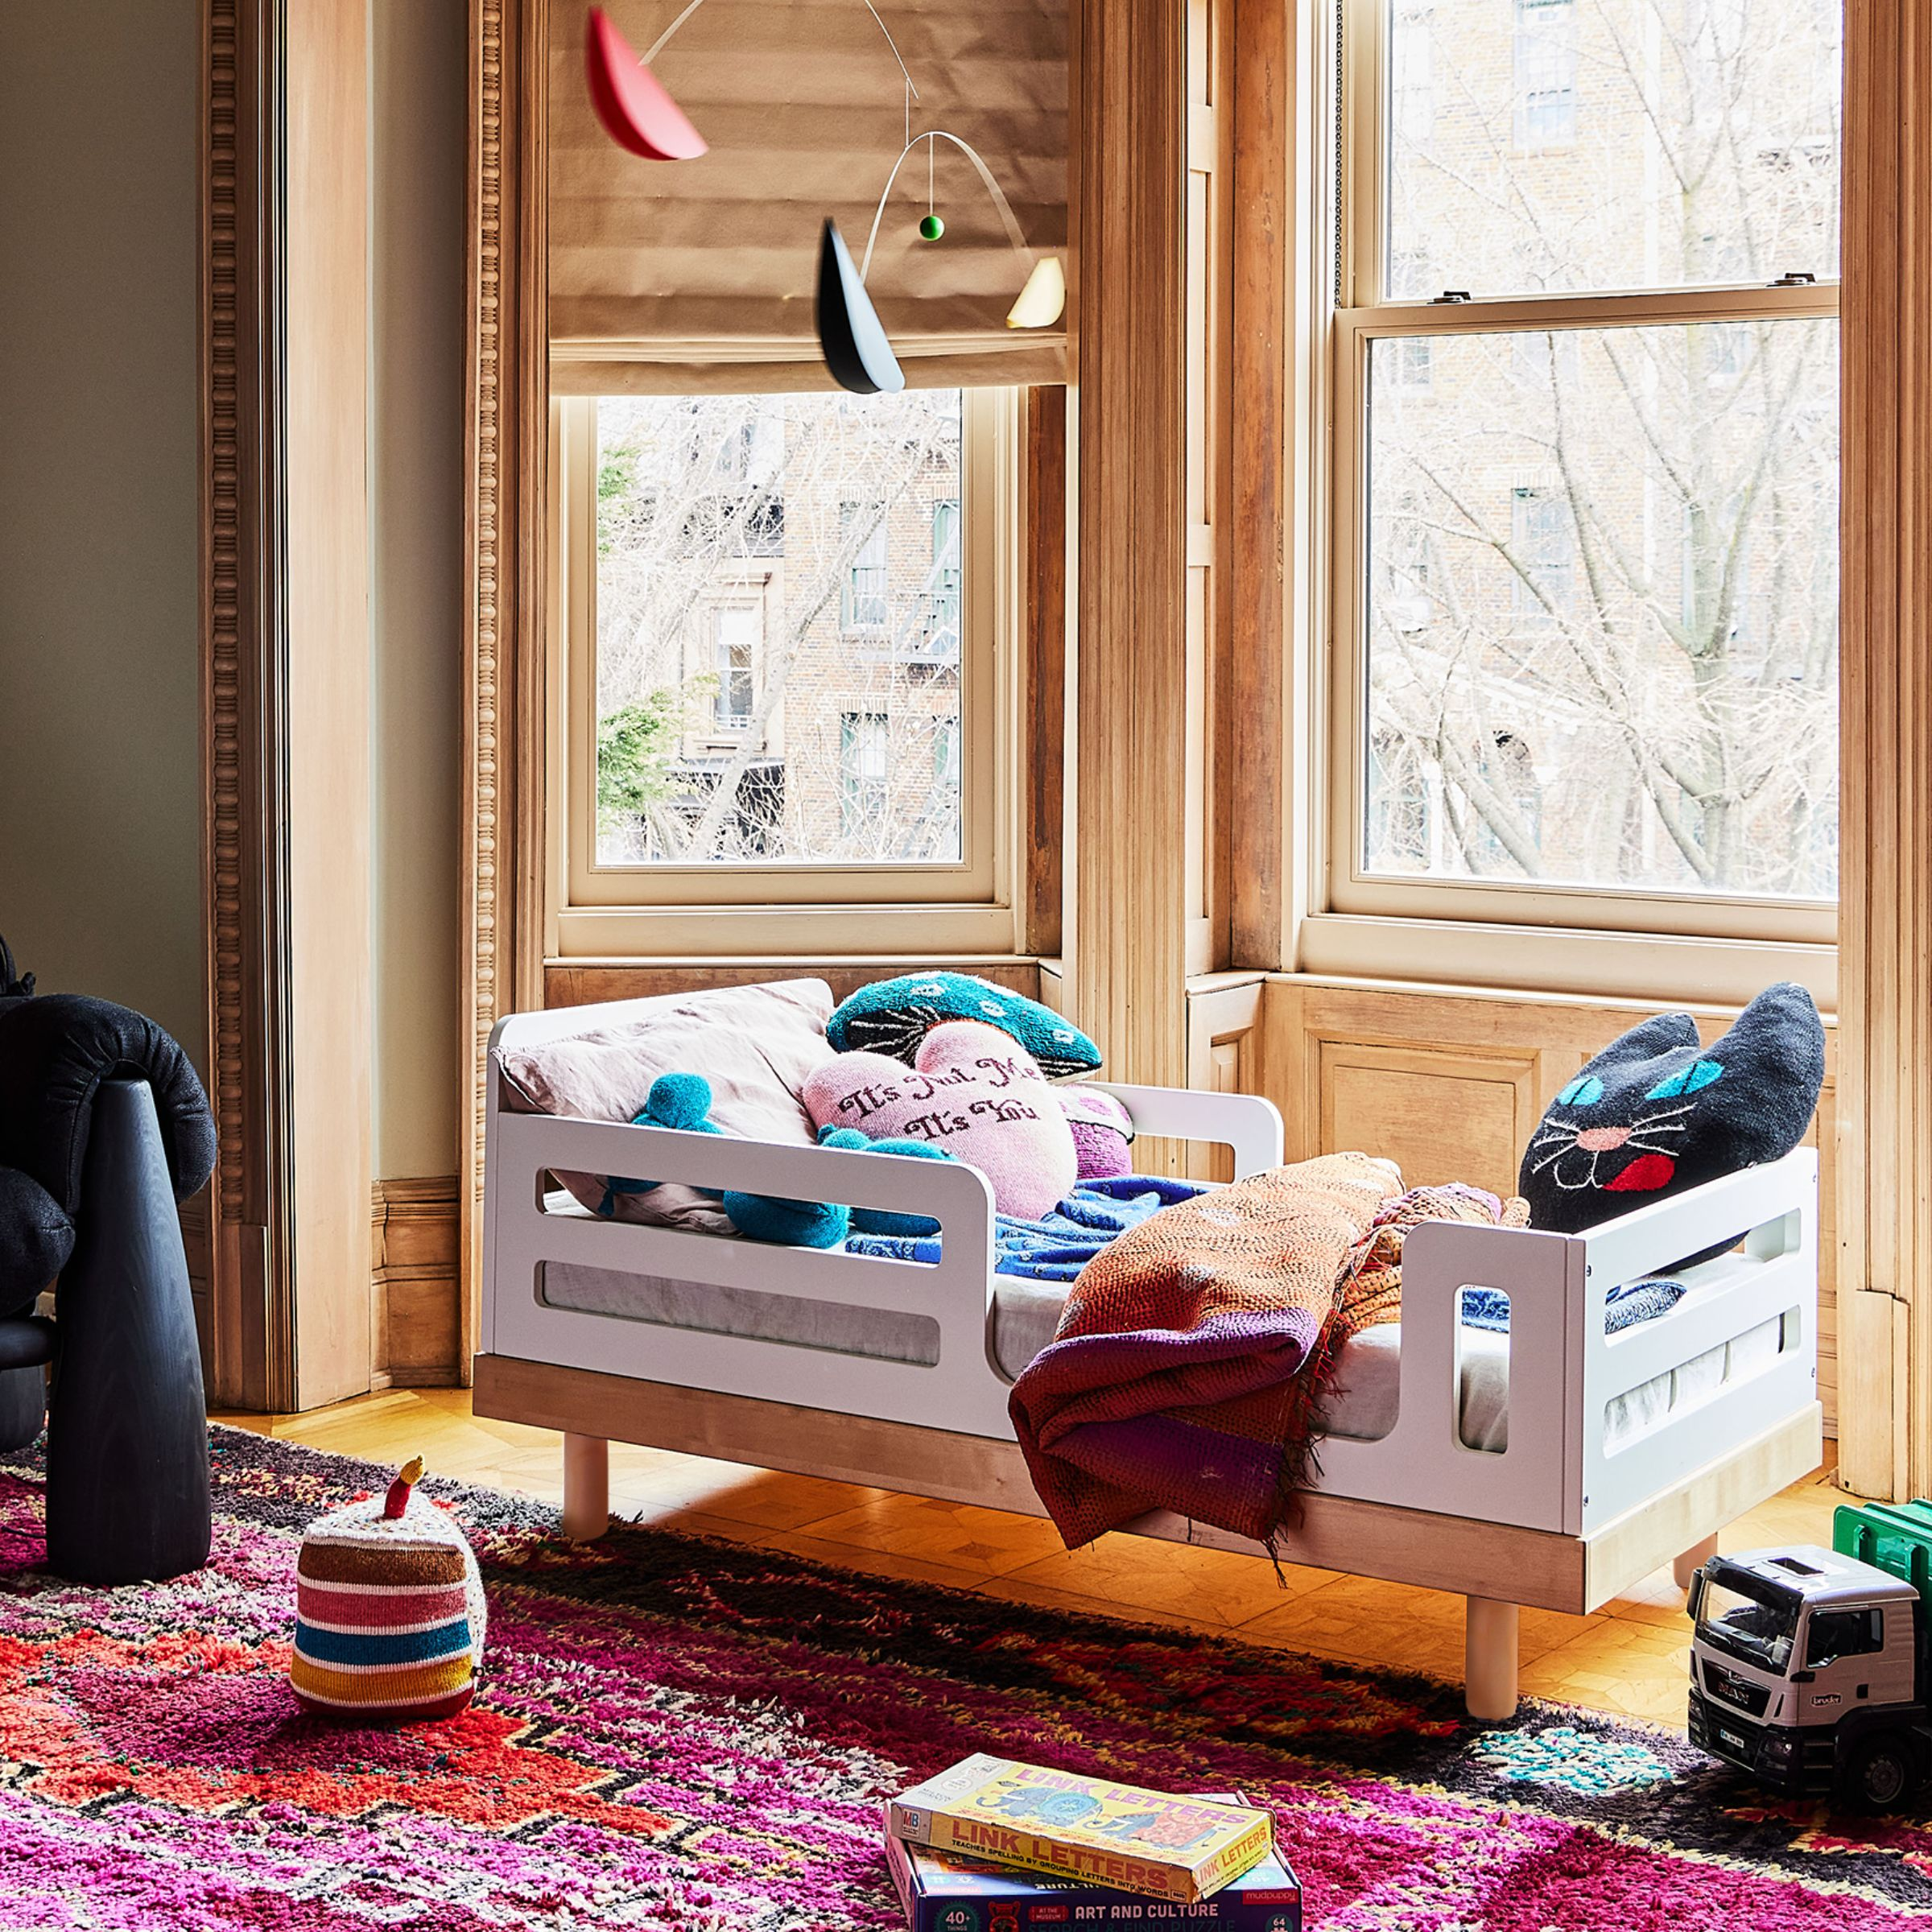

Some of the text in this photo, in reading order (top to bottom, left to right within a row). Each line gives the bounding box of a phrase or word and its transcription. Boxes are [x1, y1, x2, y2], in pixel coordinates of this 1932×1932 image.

[839, 1084, 901, 1119] It's
[976, 1057, 1037, 1088] Me
[903, 1098, 1040, 1141] It's You
[1015, 1769, 1249, 1824] LINK LETTERS
[903, 1811, 919, 1827] MB
[952, 1820, 1021, 1854] LINK
[1033, 1840, 1167, 1889] LETTERS
[952, 1839, 986, 1852] TEACHES
[989, 1848, 1025, 1862] SPELLING
[1026, 1857, 1038, 1865] BY
[1039, 1860, 1080, 1876] GROUPING
[1082, 1871, 1116, 1885] LETTERS
[1117, 1880, 1136, 1890] INTO
[1137, 1885, 1169, 1897] WORDS
[1198, 1859, 1220, 1886] INK
[1222, 1827, 1267, 1868] LETTERS
[945, 1911, 971, 1924] 40+
[1075, 1904, 1219, 1920] ART AND CULTURE
[1245, 1891, 1296, 1901] mudpuppy
[1273, 1918, 1286, 1926] 64
